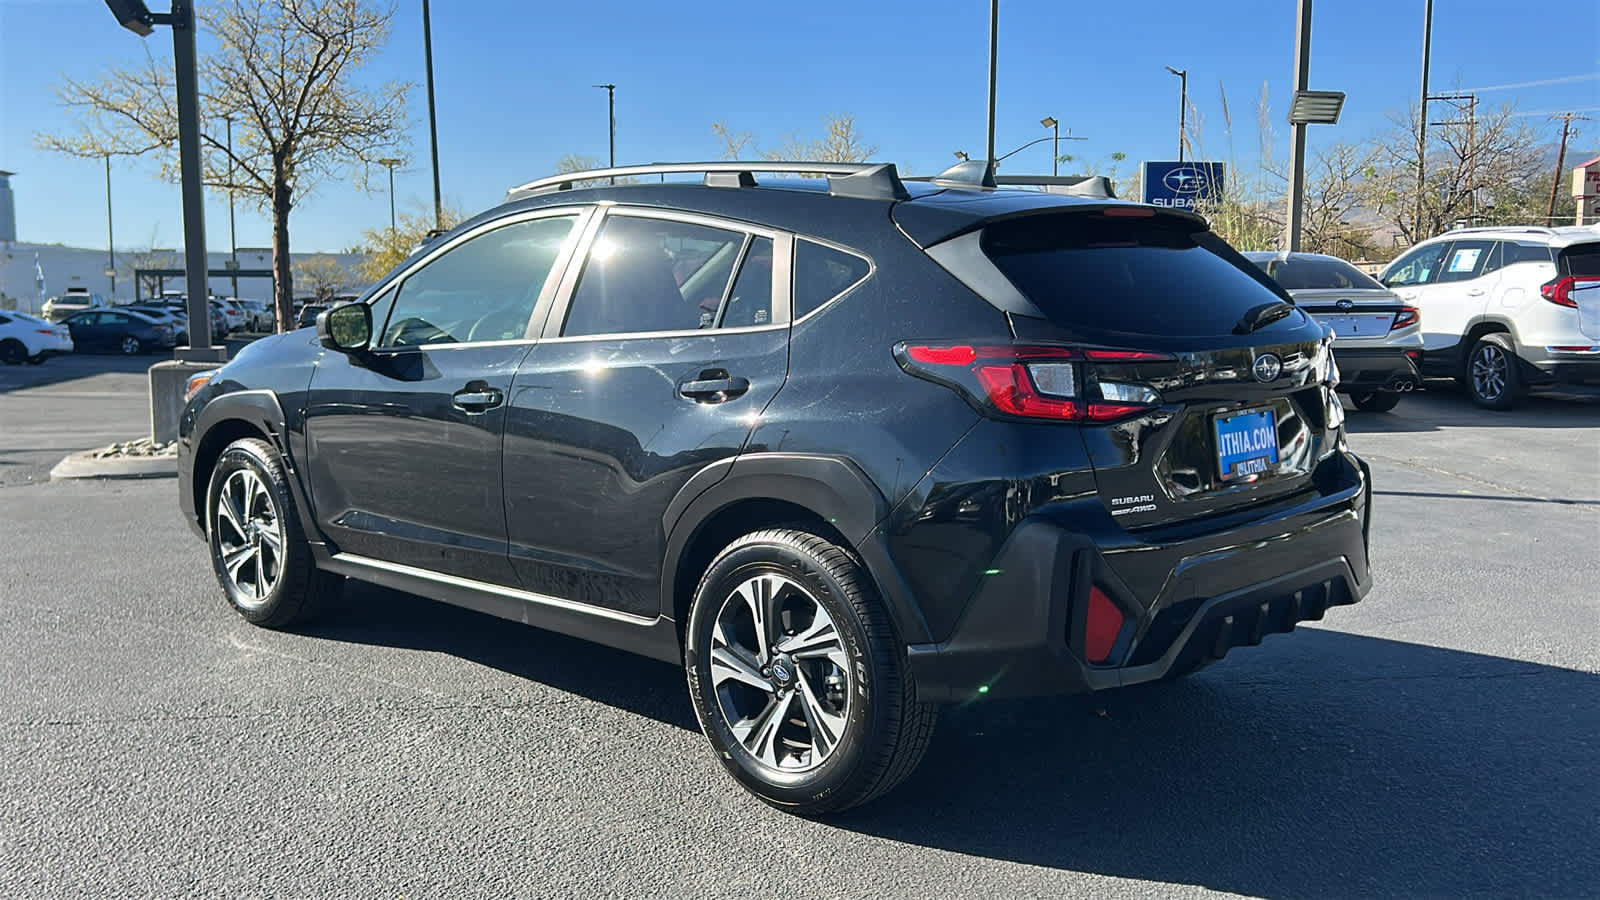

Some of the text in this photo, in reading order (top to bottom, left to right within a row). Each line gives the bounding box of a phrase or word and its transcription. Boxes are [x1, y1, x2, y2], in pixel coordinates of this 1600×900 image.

[1152, 198, 1217, 208] SUBARU
[1219, 425, 1276, 457] ITHIA.COM
[1111, 494, 1154, 505] SUBARU
